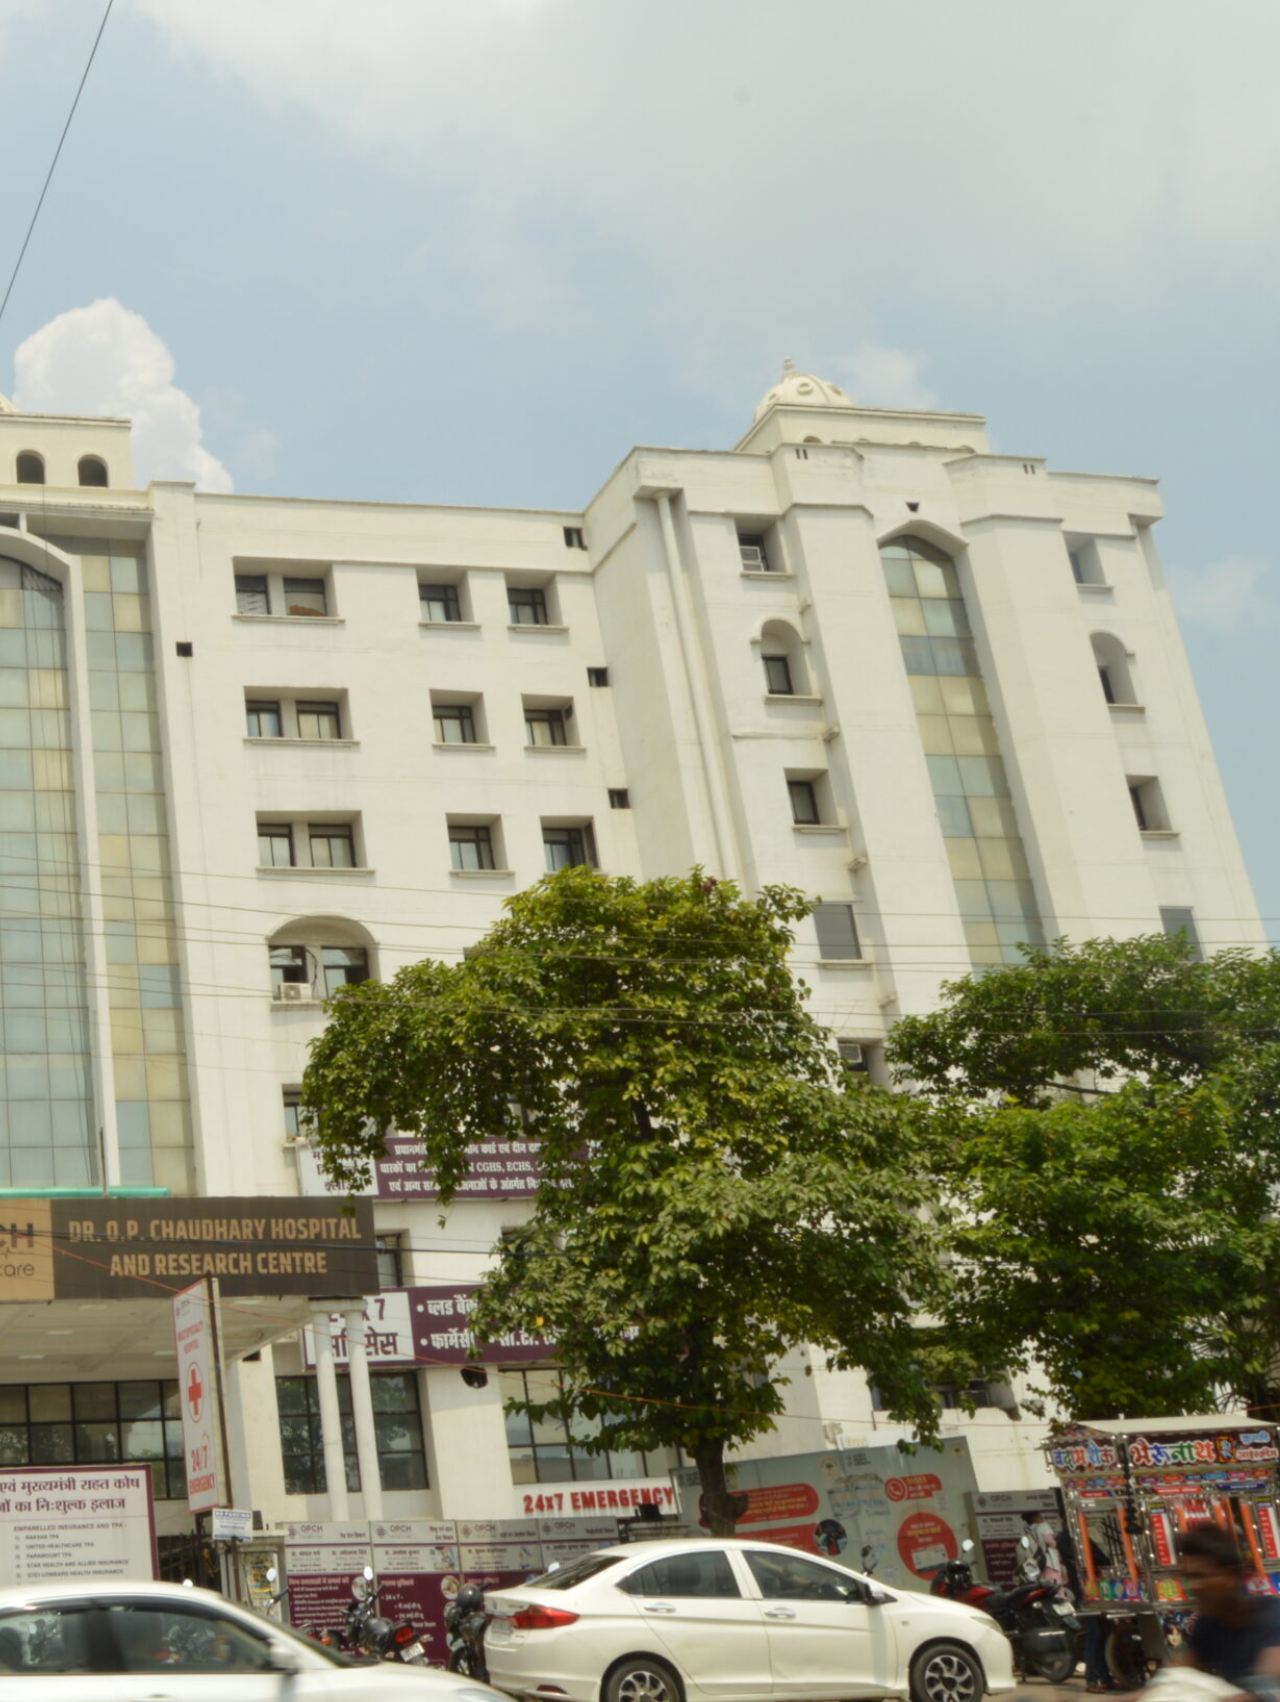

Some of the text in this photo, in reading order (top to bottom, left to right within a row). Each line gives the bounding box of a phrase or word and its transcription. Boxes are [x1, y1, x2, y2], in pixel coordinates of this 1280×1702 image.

[476, 1160, 505, 1174] CGHS,
[506, 1160, 534, 1173] ECHS,
[68, 1220, 101, 1243] DR.
[150, 1218, 266, 1241] CHAUDHARY
[271, 1217, 362, 1240] HOSPITAL
[110, 1251, 328, 1277] AND RESEARCH CENTRE
[20, 1477, 77, 1496] मुख्यमंत्री
[80, 1478, 110, 1491] राहत
[113, 1474, 140, 1490] कोष
[15, 1500, 32, 1513] का
[90, 1497, 127, 1513] इलाज
[522, 1486, 674, 1513] 24x7 EMERGENCY
